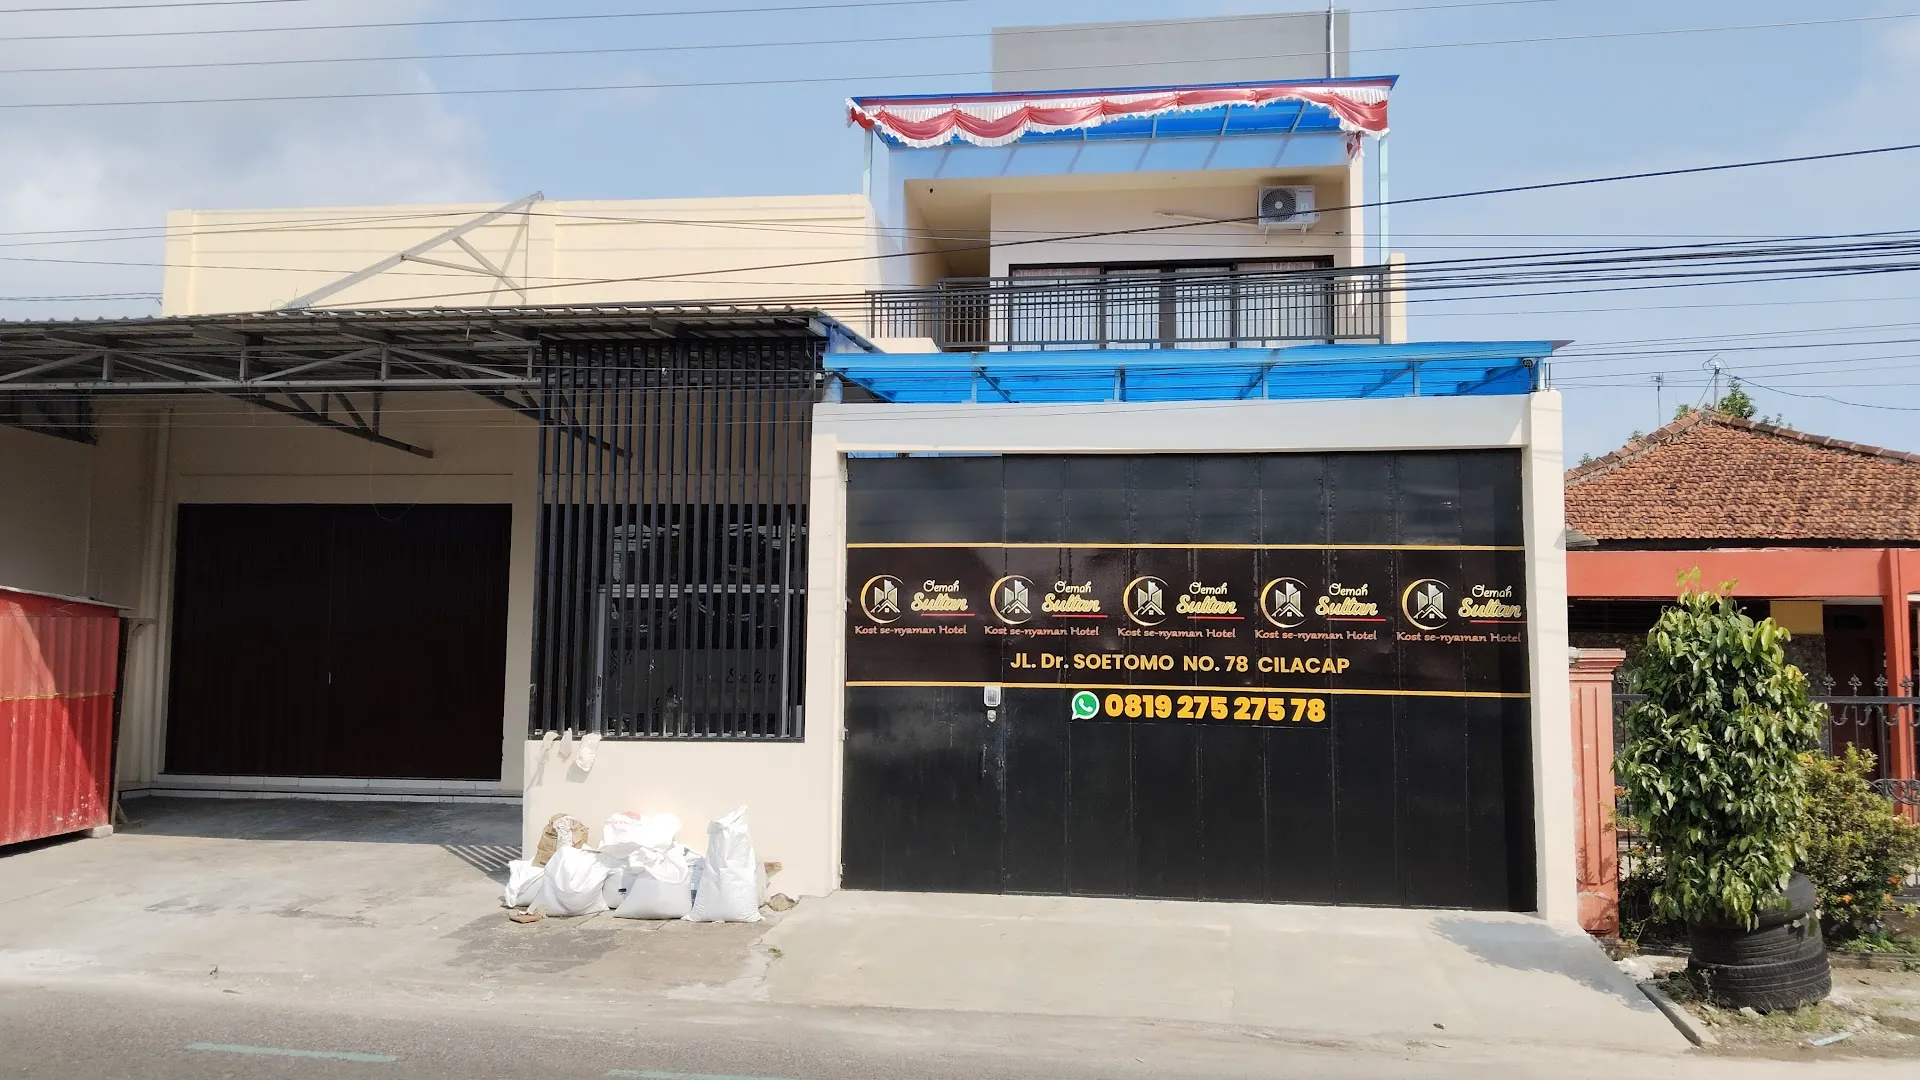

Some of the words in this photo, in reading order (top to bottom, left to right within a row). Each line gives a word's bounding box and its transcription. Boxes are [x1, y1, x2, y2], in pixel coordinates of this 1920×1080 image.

[923, 580, 960, 593] Oemah
[1054, 580, 1092, 594] Oemah
[1189, 581, 1228, 595] Oemah
[1328, 583, 1369, 597] Oemah
[1471, 584, 1513, 599] Oemah
[910, 592, 969, 612] Sultan
[1041, 593, 1101, 613] Sultan
[1176, 594, 1237, 615] Sultan
[1315, 596, 1379, 616] Sultan
[1458, 597, 1522, 619] Sultan
[854, 625, 878, 635] Kost
[879, 626, 937, 637] se-nyaman
[938, 624, 968, 635] Hotel
[983, 625, 1008, 635] Kost
[1009, 627, 1068, 638] se-nyaman
[1070, 625, 1100, 636] Hotel
[1117, 627, 1141, 637] Kost
[1143, 629, 1204, 640] se-nyaman
[1206, 627, 1237, 638] Hotel
[1254, 629, 1279, 639] Kost
[1281, 631, 1343, 642] se-nyaman
[1345, 629, 1378, 640] Hotel
[1396, 631, 1422, 641] Kost
[1424, 633, 1488, 645] se-nyaman
[1489, 632, 1522, 643] Hotel
[1010, 652, 1037, 669] JL.
[1041, 653, 1069, 669] Dr.
[1073, 653, 1175, 671] SOETOMO
[1183, 655, 1220, 672] NO.
[1224, 655, 1249, 673] 78
[1257, 656, 1350, 674] CILACAP
[1104, 693, 1173, 719] 0819
[1176, 695, 1229, 720] 275
[1233, 696, 1286, 722] 275
[1290, 698, 1326, 723] 78
